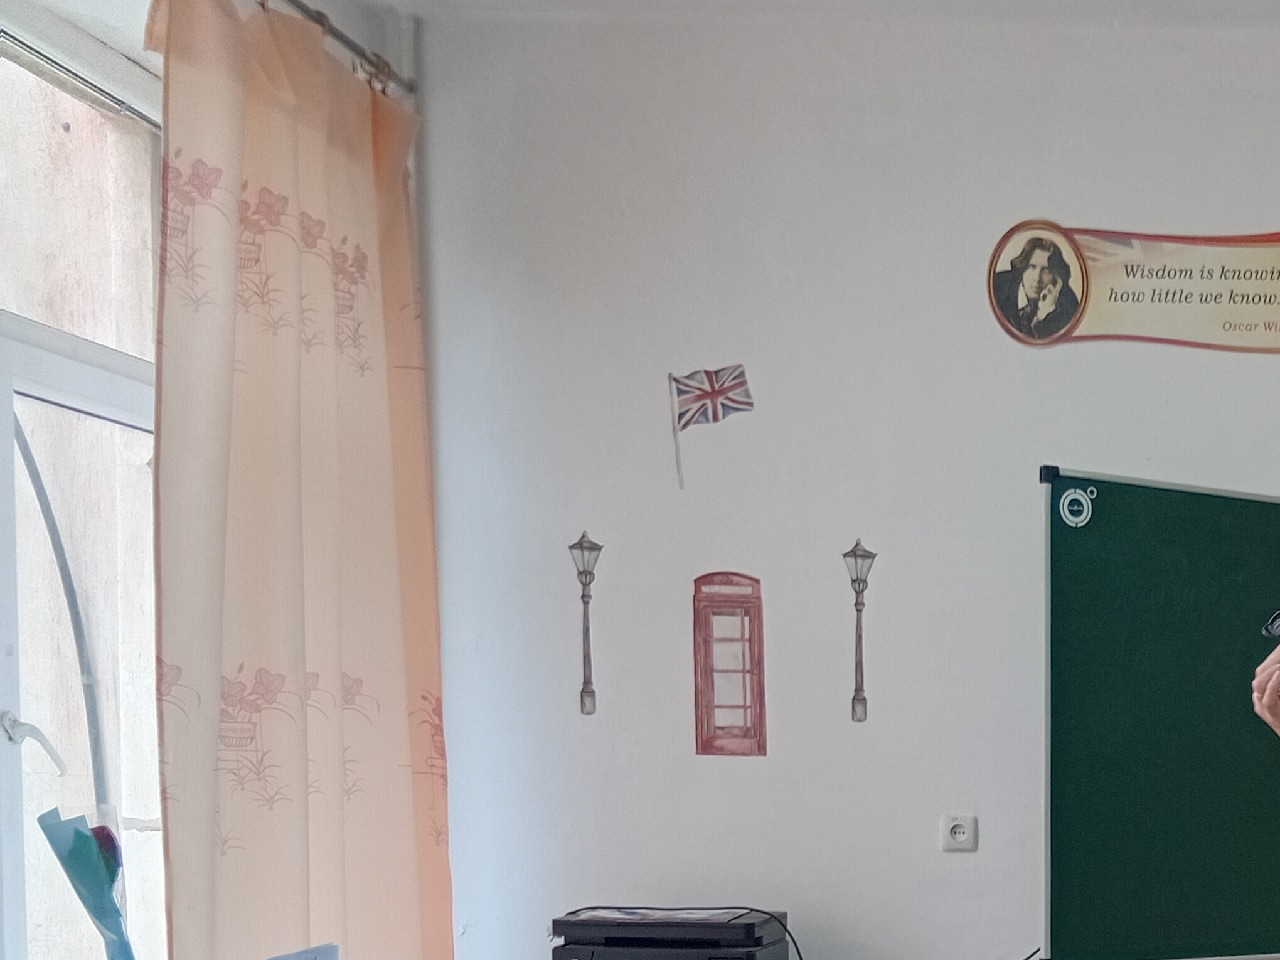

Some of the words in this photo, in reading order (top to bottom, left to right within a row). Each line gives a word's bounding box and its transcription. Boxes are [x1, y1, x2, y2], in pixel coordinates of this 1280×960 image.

[1124, 264, 1194, 281] Wisdom
[1199, 264, 1214, 281] is
[1108, 288, 1145, 304] how
[1151, 288, 1193, 304] little
[1199, 293, 1222, 304] we
[1229, 290, 1280, 306] know.
[1222, 320, 1259, 333] Oscar
